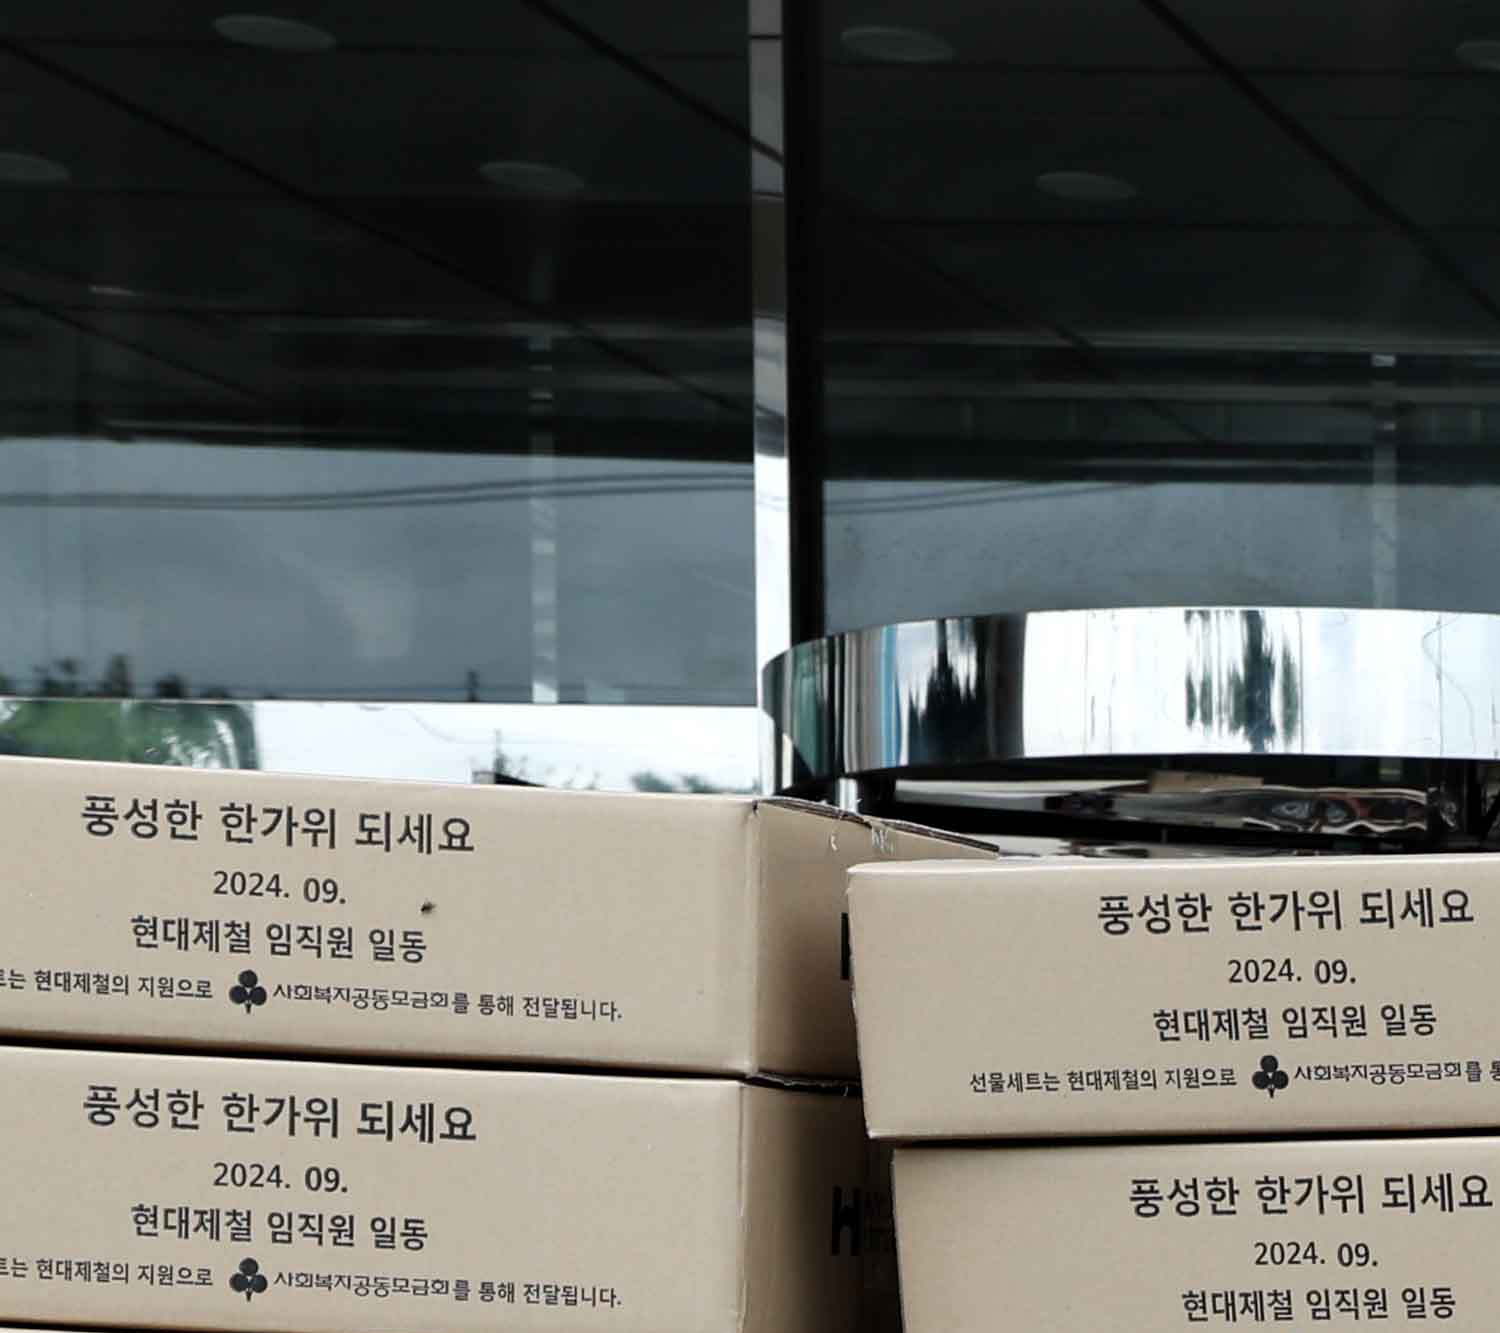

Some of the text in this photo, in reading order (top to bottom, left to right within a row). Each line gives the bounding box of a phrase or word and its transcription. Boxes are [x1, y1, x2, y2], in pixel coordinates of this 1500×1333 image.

[80, 795, 475, 856] 풍성한 한가위 되세요
[212, 870, 347, 905] 2024. 09.
[1097, 887, 1475, 936] 풍성한 한가위 되세요
[130, 914, 428, 964] 현대제철 임직원 일동
[1227, 957, 1357, 985] 2024. 09.
[33, 969, 129, 997] 현대제철의
[137, 975, 214, 999] 지원으로
[477, 993, 514, 1017] 통해
[522, 996, 623, 1023] 전달됩니다.
[1152, 1003, 1438, 1043] 현대제철 임직원 일동
[969, 1071, 1061, 1094] 선물세트는
[1066, 1068, 1158, 1092] 현대제철의
[1164, 1067, 1238, 1090] 지원으로
